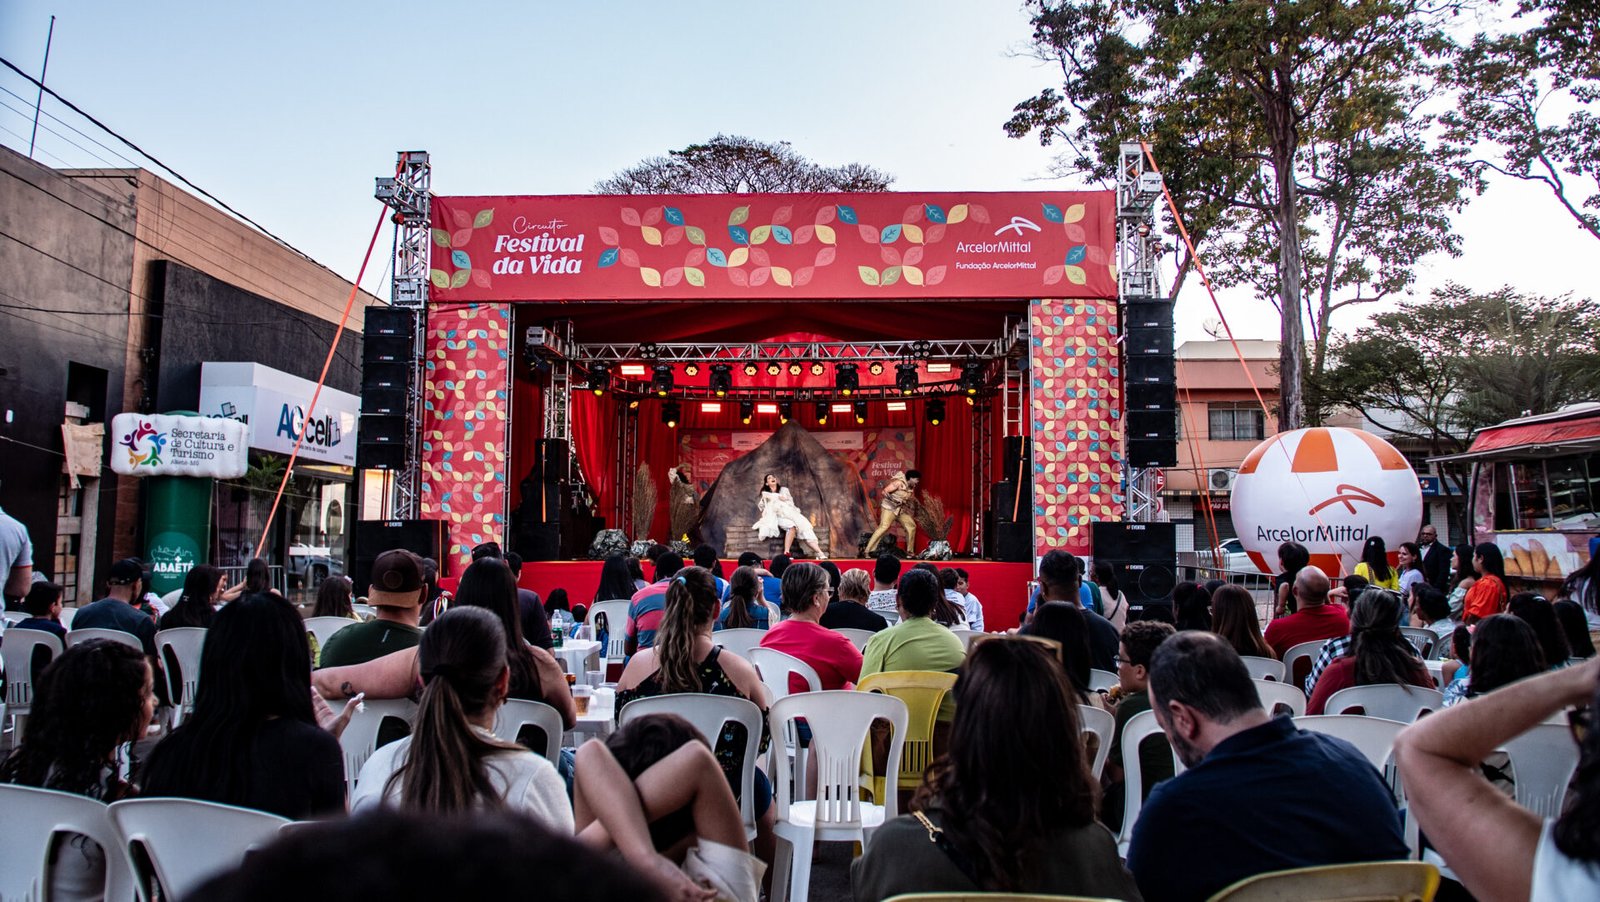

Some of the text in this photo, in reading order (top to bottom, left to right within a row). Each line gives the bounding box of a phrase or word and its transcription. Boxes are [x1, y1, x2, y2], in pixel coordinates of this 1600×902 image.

[513, 216, 568, 234] Circuito
[494, 232, 585, 253] Festival
[956, 241, 1031, 253] ArcelorMittal
[492, 254, 582, 275] da Vida
[955, 262, 991, 270] Fundação
[171, 428, 226, 441] Secretaria
[170, 440, 235, 452] de Cultura e
[170, 448, 215, 460] Turismo
[872, 461, 902, 469] Festival
[1257, 524, 1369, 542] ArcelorMittal
[153, 560, 194, 573] ABAETÉ
